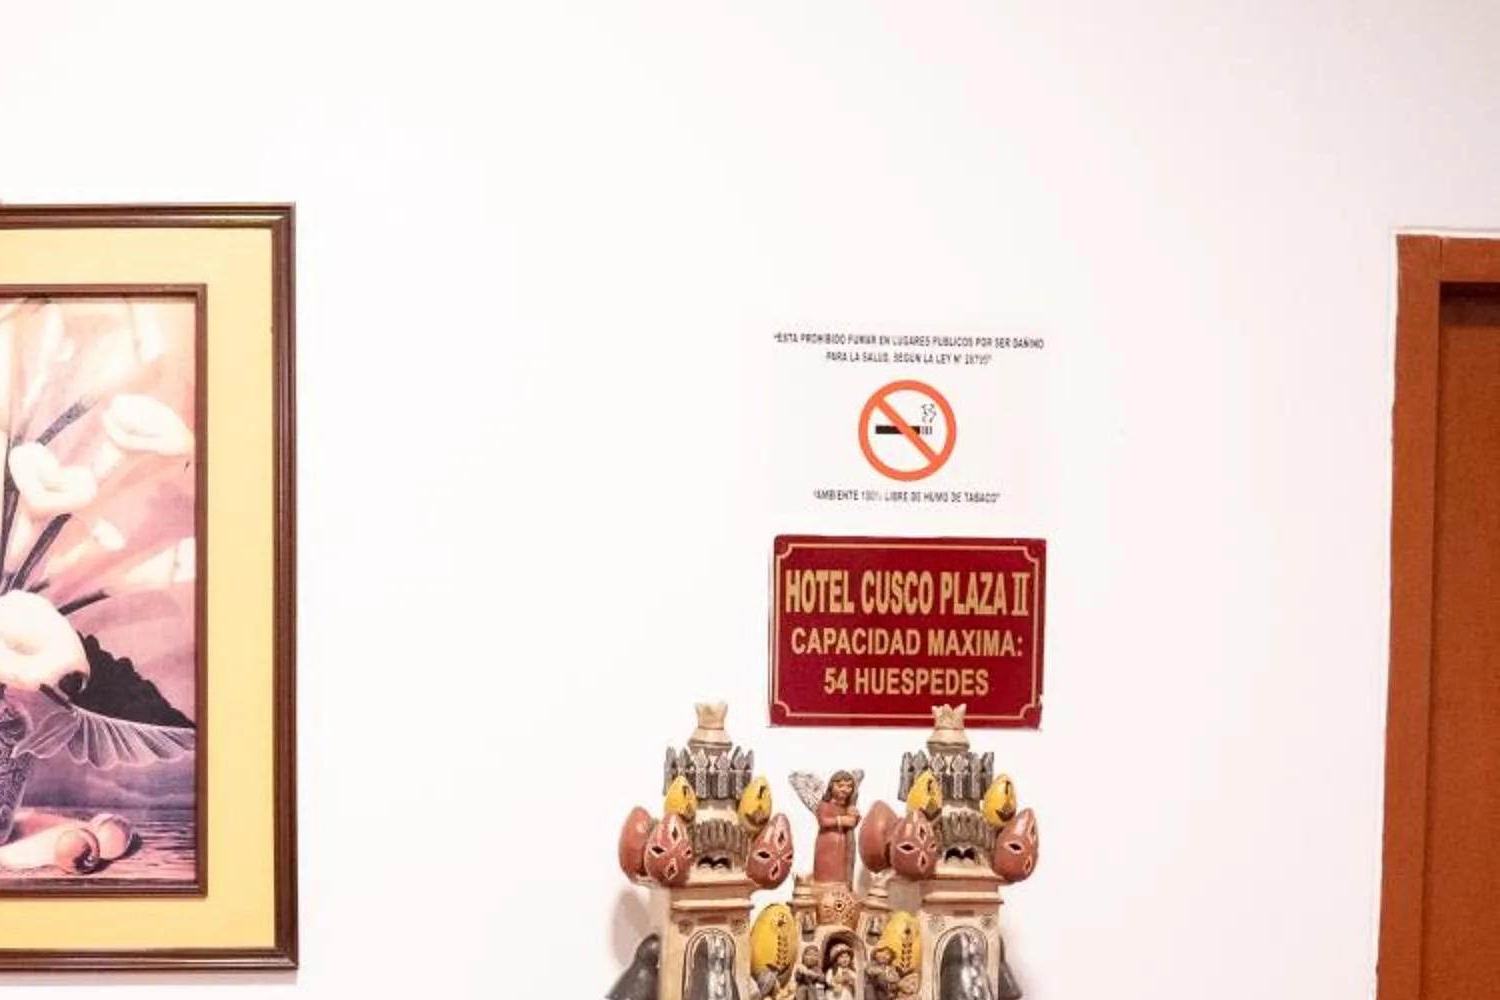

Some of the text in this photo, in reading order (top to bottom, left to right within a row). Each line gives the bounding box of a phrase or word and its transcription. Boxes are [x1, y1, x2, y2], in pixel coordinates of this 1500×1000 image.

[801, 333, 846, 345] PROHIBIDO
[848, 333, 876, 345] FUMAR
[879, 335, 890, 345] EN
[893, 335, 931, 346] LUGARES
[976, 337, 992, 348] POR
[995, 338, 1011, 348] SER
[826, 352, 846, 360] PARA
[850, 352, 860, 362] LA
[924, 353, 934, 363] LA
[936, 353, 951, 364] LEY
[884, 491, 908, 502] LIBRE
[911, 492, 922, 502] DE
[924, 492, 948, 502] HUMO
[951, 492, 962, 502] DE
[785, 569, 1030, 616] HOTEL CUSCO PLAZA II
[791, 627, 1023, 657] CAPACIDAD MAXIMA:
[824, 667, 989, 696] 54 HUESPEDES
